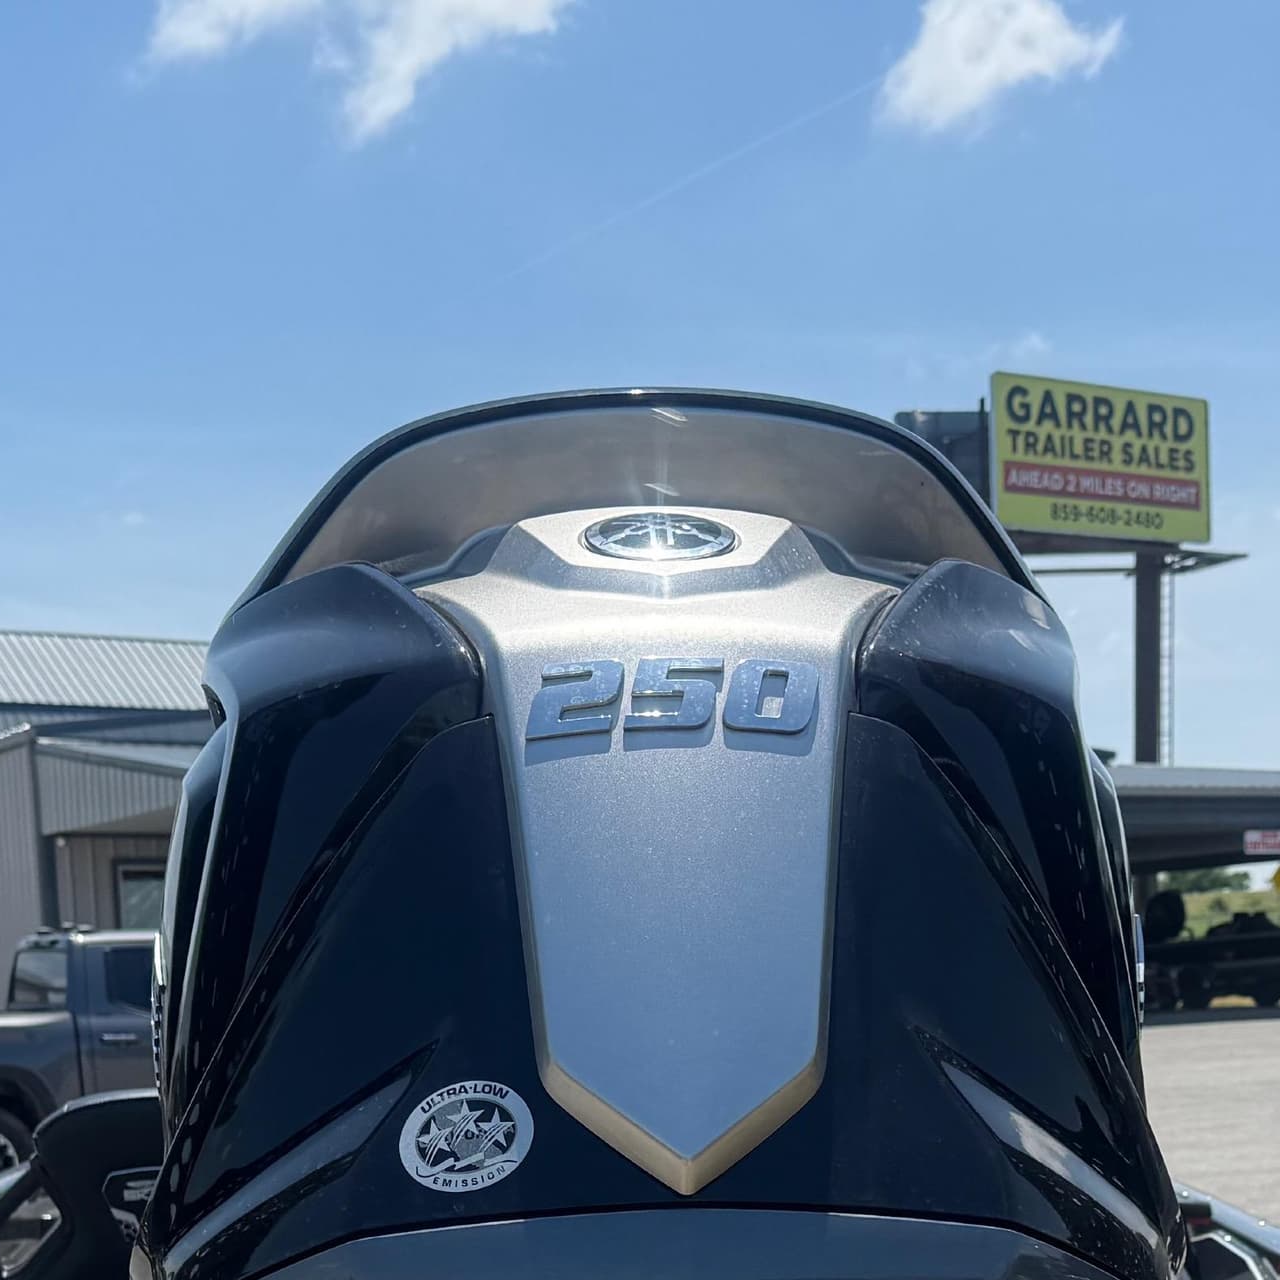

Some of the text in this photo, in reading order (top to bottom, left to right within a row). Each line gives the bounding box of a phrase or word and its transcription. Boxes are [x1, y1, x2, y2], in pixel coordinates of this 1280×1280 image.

[1006, 384, 1195, 443] GARRARD
[1007, 428, 1195, 472] TRAILER SALES
[1007, 469, 1197, 505] AHEAD 2 MILES ON RIGHT
[525, 656, 820, 742] 250
[432, 1164, 506, 1188] EMISSION
